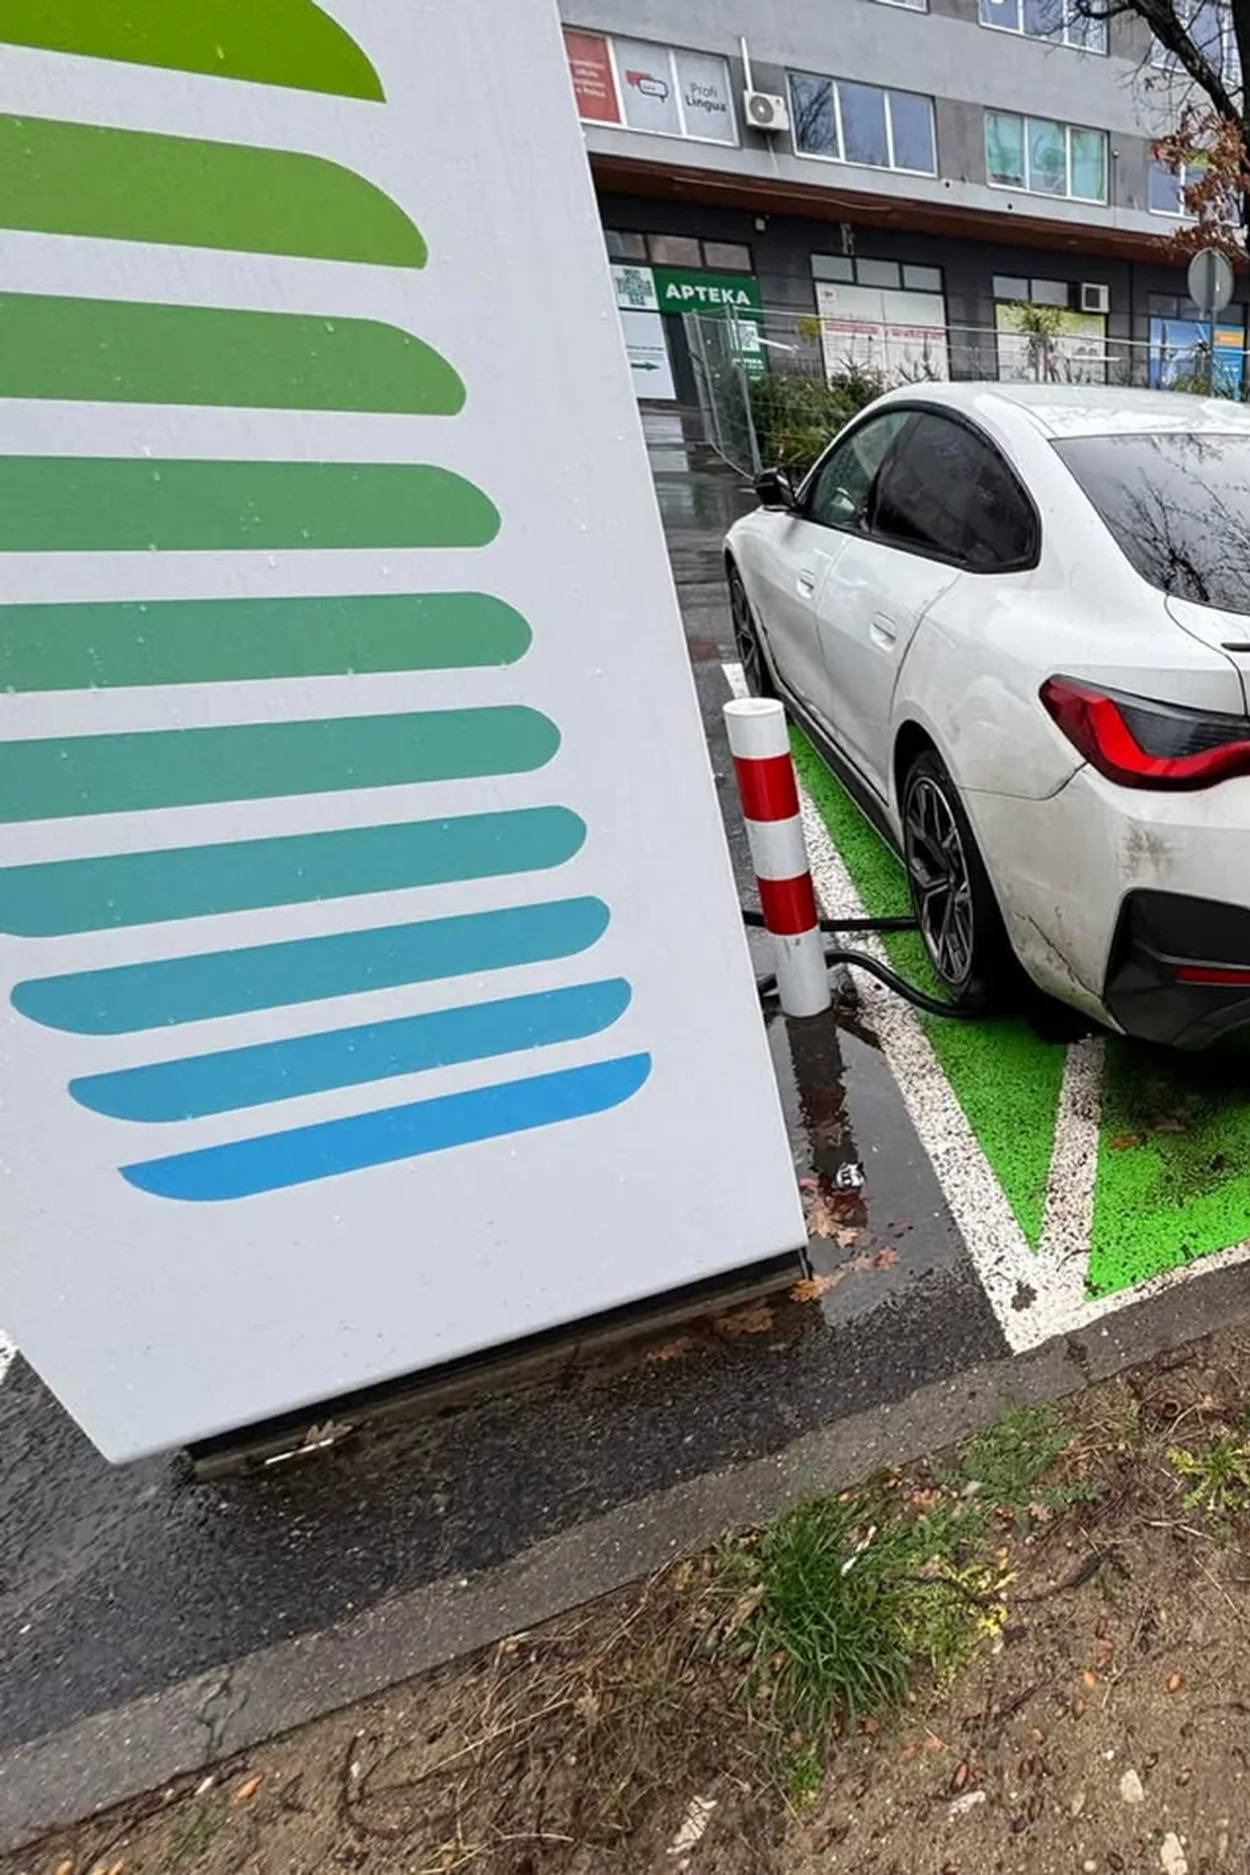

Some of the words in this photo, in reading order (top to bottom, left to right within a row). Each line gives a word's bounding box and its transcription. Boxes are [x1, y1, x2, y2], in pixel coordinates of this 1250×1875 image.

[690, 82, 718, 98] Profi
[685, 95, 727, 113] Lingua
[665, 283, 751, 305] APTEKA
